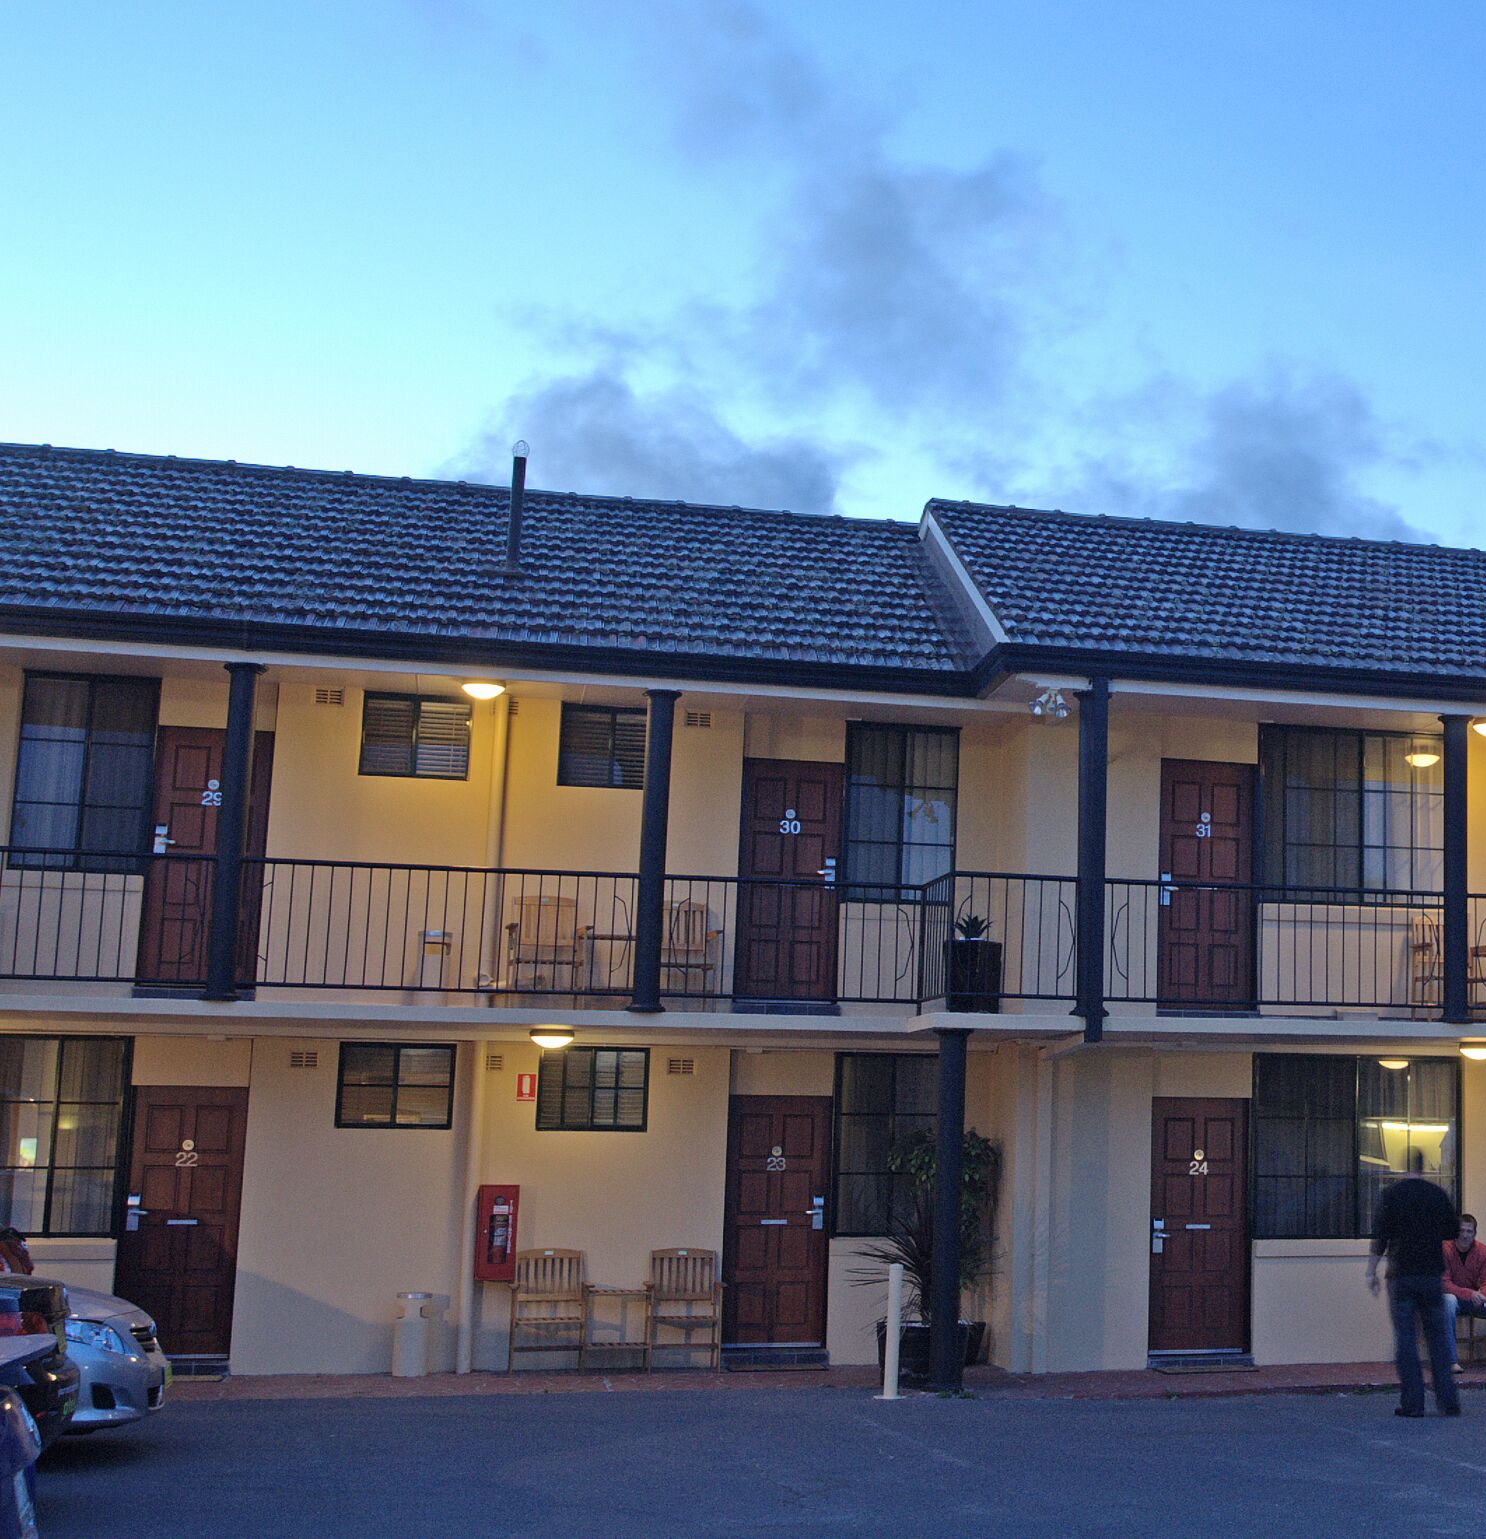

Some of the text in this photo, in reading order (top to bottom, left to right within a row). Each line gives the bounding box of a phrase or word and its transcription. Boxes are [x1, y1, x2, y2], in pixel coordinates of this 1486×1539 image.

[201, 791, 222, 806] 29
[780, 820, 801, 834] 30
[1195, 824, 1211, 838] 31
[175, 1152, 198, 1167] 22
[767, 1157, 786, 1171] 23
[1189, 1161, 1209, 1175] 24
